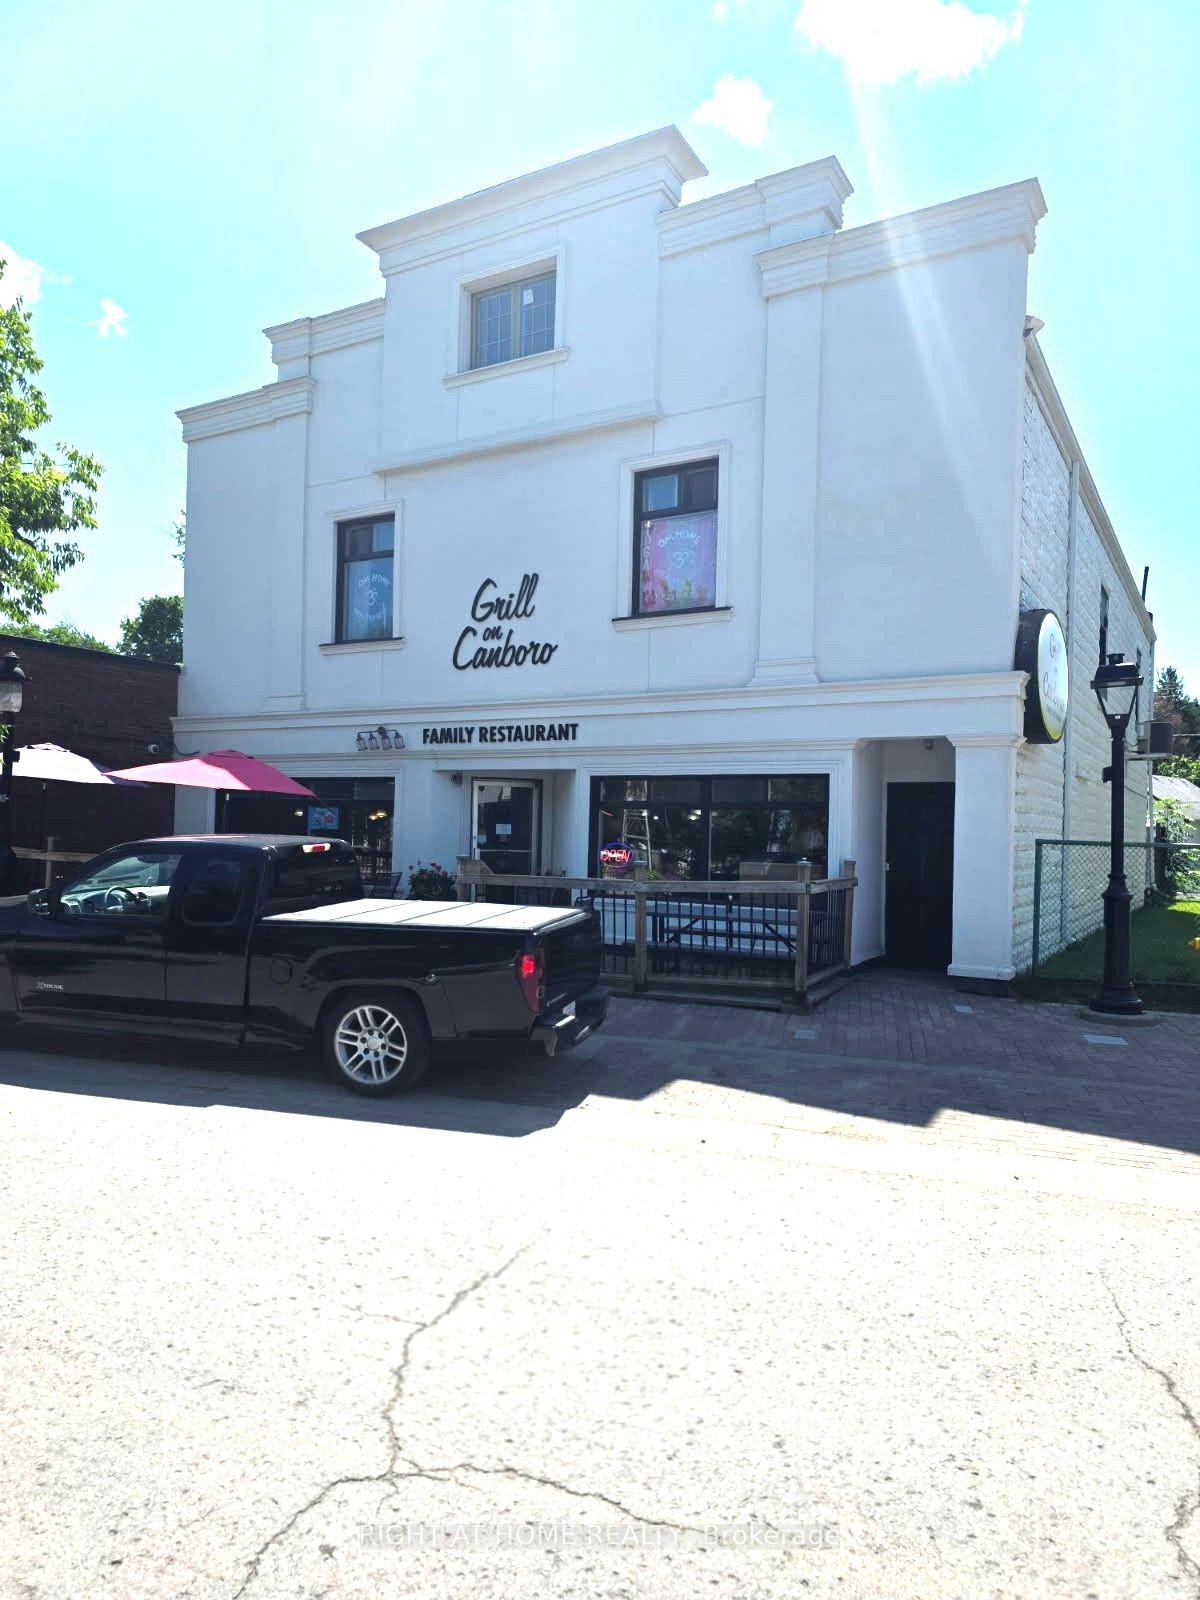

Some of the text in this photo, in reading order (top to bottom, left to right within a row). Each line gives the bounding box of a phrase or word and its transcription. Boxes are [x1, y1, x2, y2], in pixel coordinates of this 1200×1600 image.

[470, 573, 540, 623] Grill
[482, 625, 504, 641] on
[452, 625, 559, 671] Canboro
[422, 723, 579, 745] FAMILY RESTAURANT
[600, 849, 631, 863] OPEN
